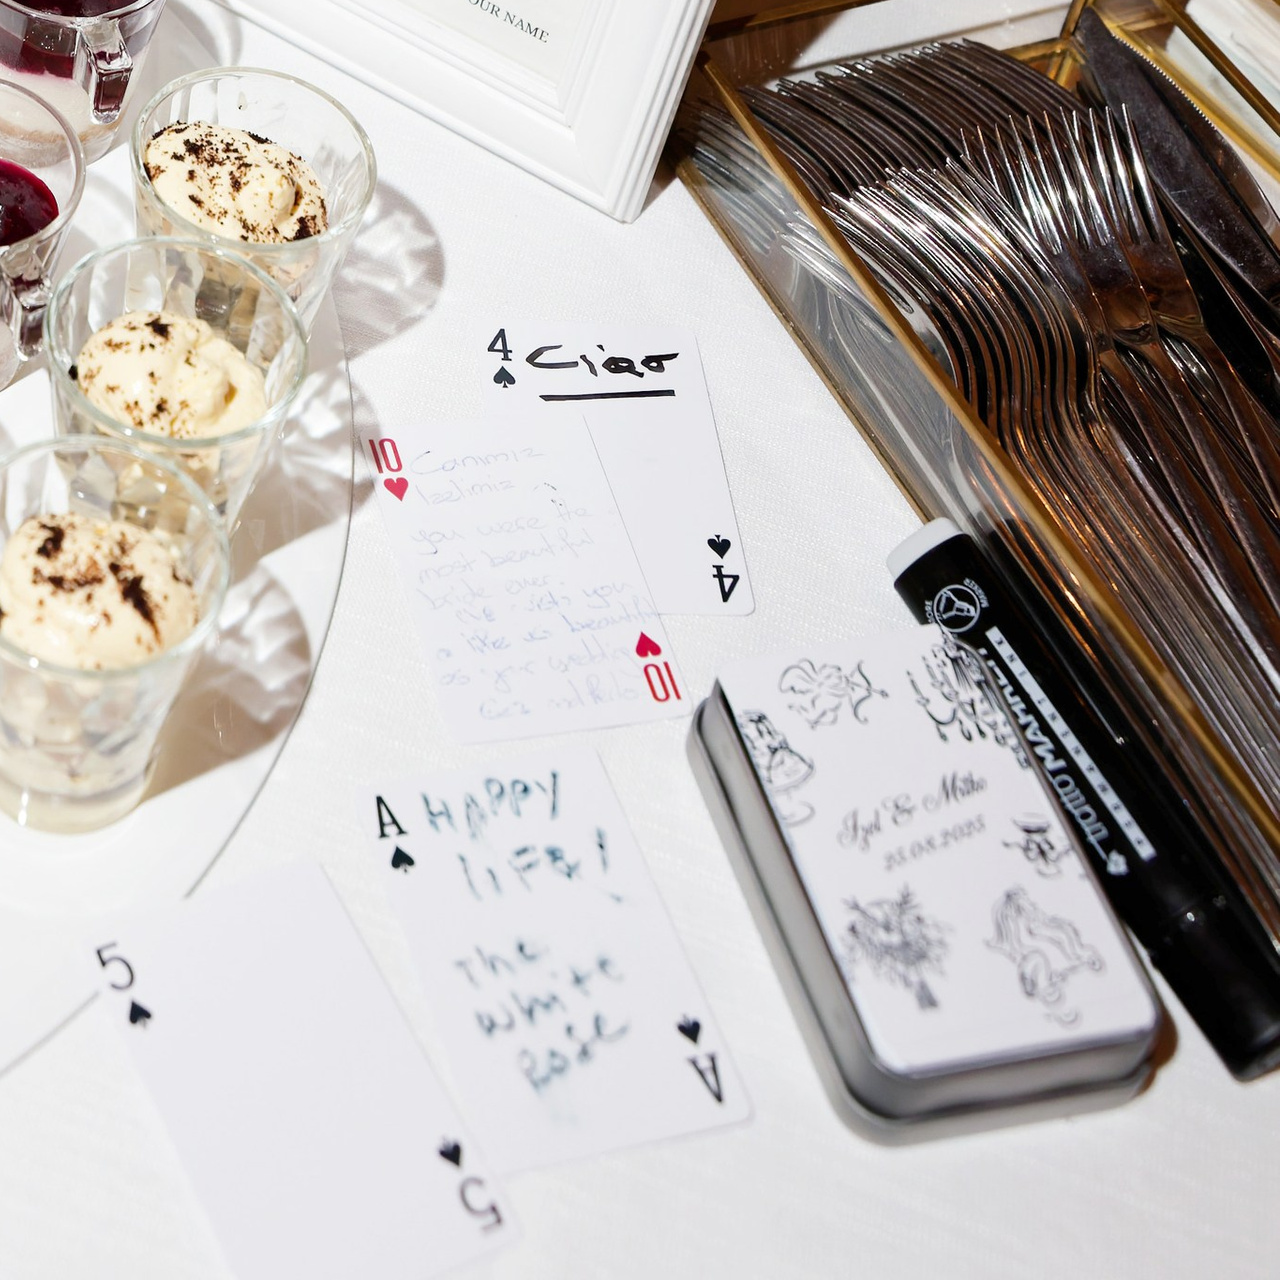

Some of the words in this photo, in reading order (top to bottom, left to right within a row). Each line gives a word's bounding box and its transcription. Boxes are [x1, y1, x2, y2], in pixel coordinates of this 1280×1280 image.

[503, 11, 549, 43] NAME
[487, 328, 513, 362] 4
[525, 344, 680, 378] Ciao
[369, 438, 403, 474] 10
[712, 565, 740, 603] 4
[643, 661, 682, 703] 10
[375, 795, 408, 839] A
[96, 943, 135, 990] 5
[689, 1054, 724, 1105] A
[458, 1177, 504, 1233] 5
